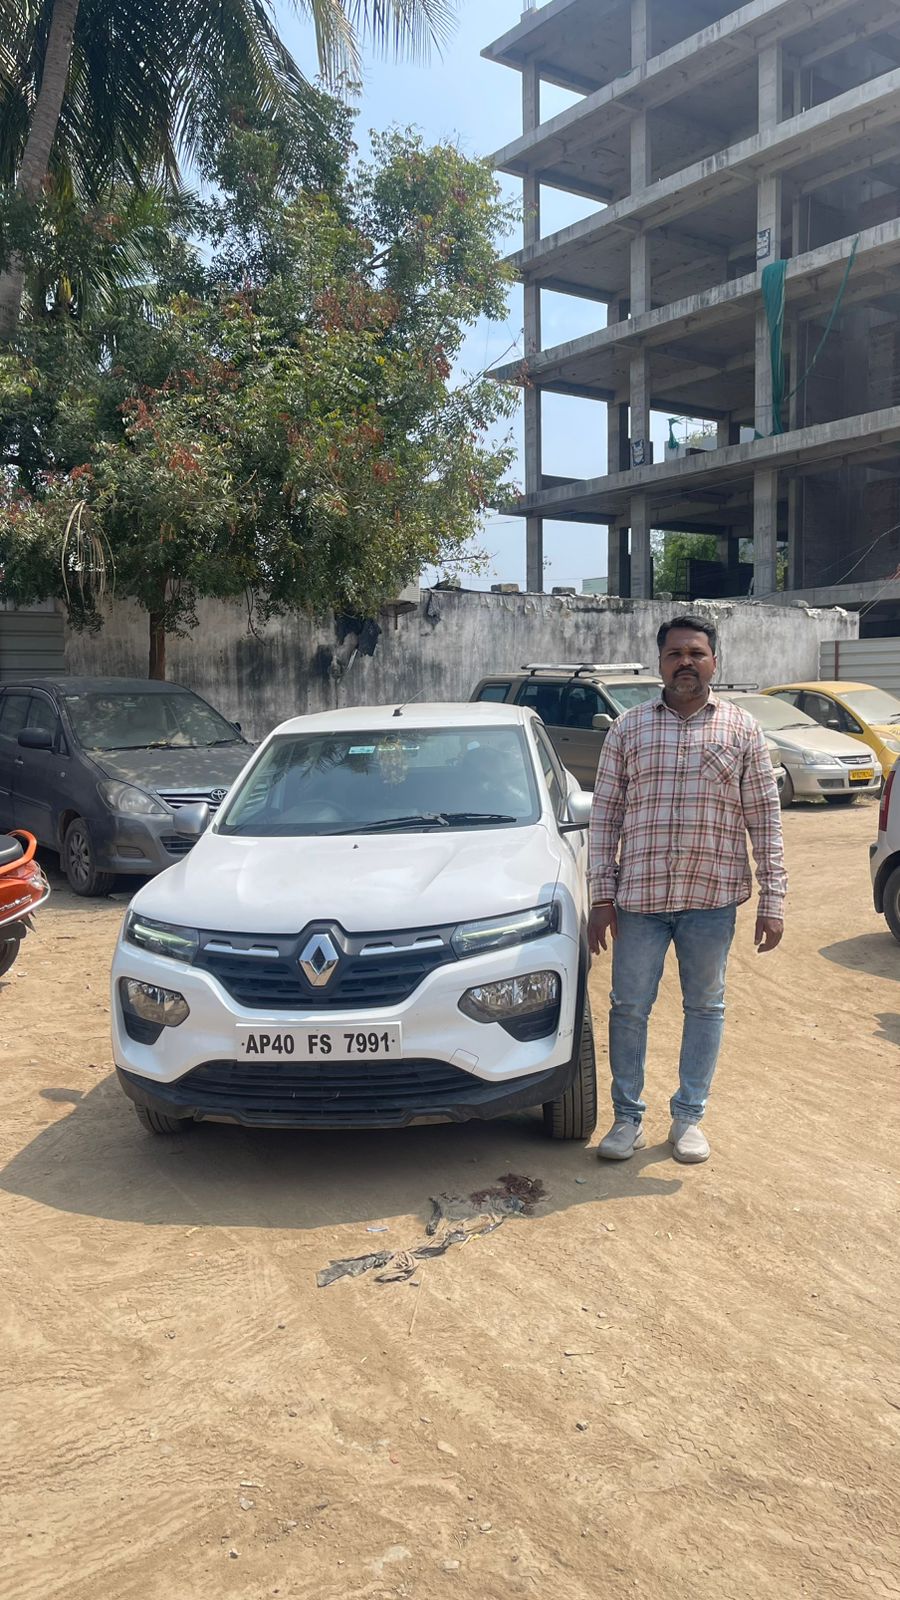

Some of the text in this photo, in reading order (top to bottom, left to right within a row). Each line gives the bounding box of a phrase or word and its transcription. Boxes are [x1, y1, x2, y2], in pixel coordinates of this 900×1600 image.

[246, 1032, 390, 1054] AP40 FS 7991
